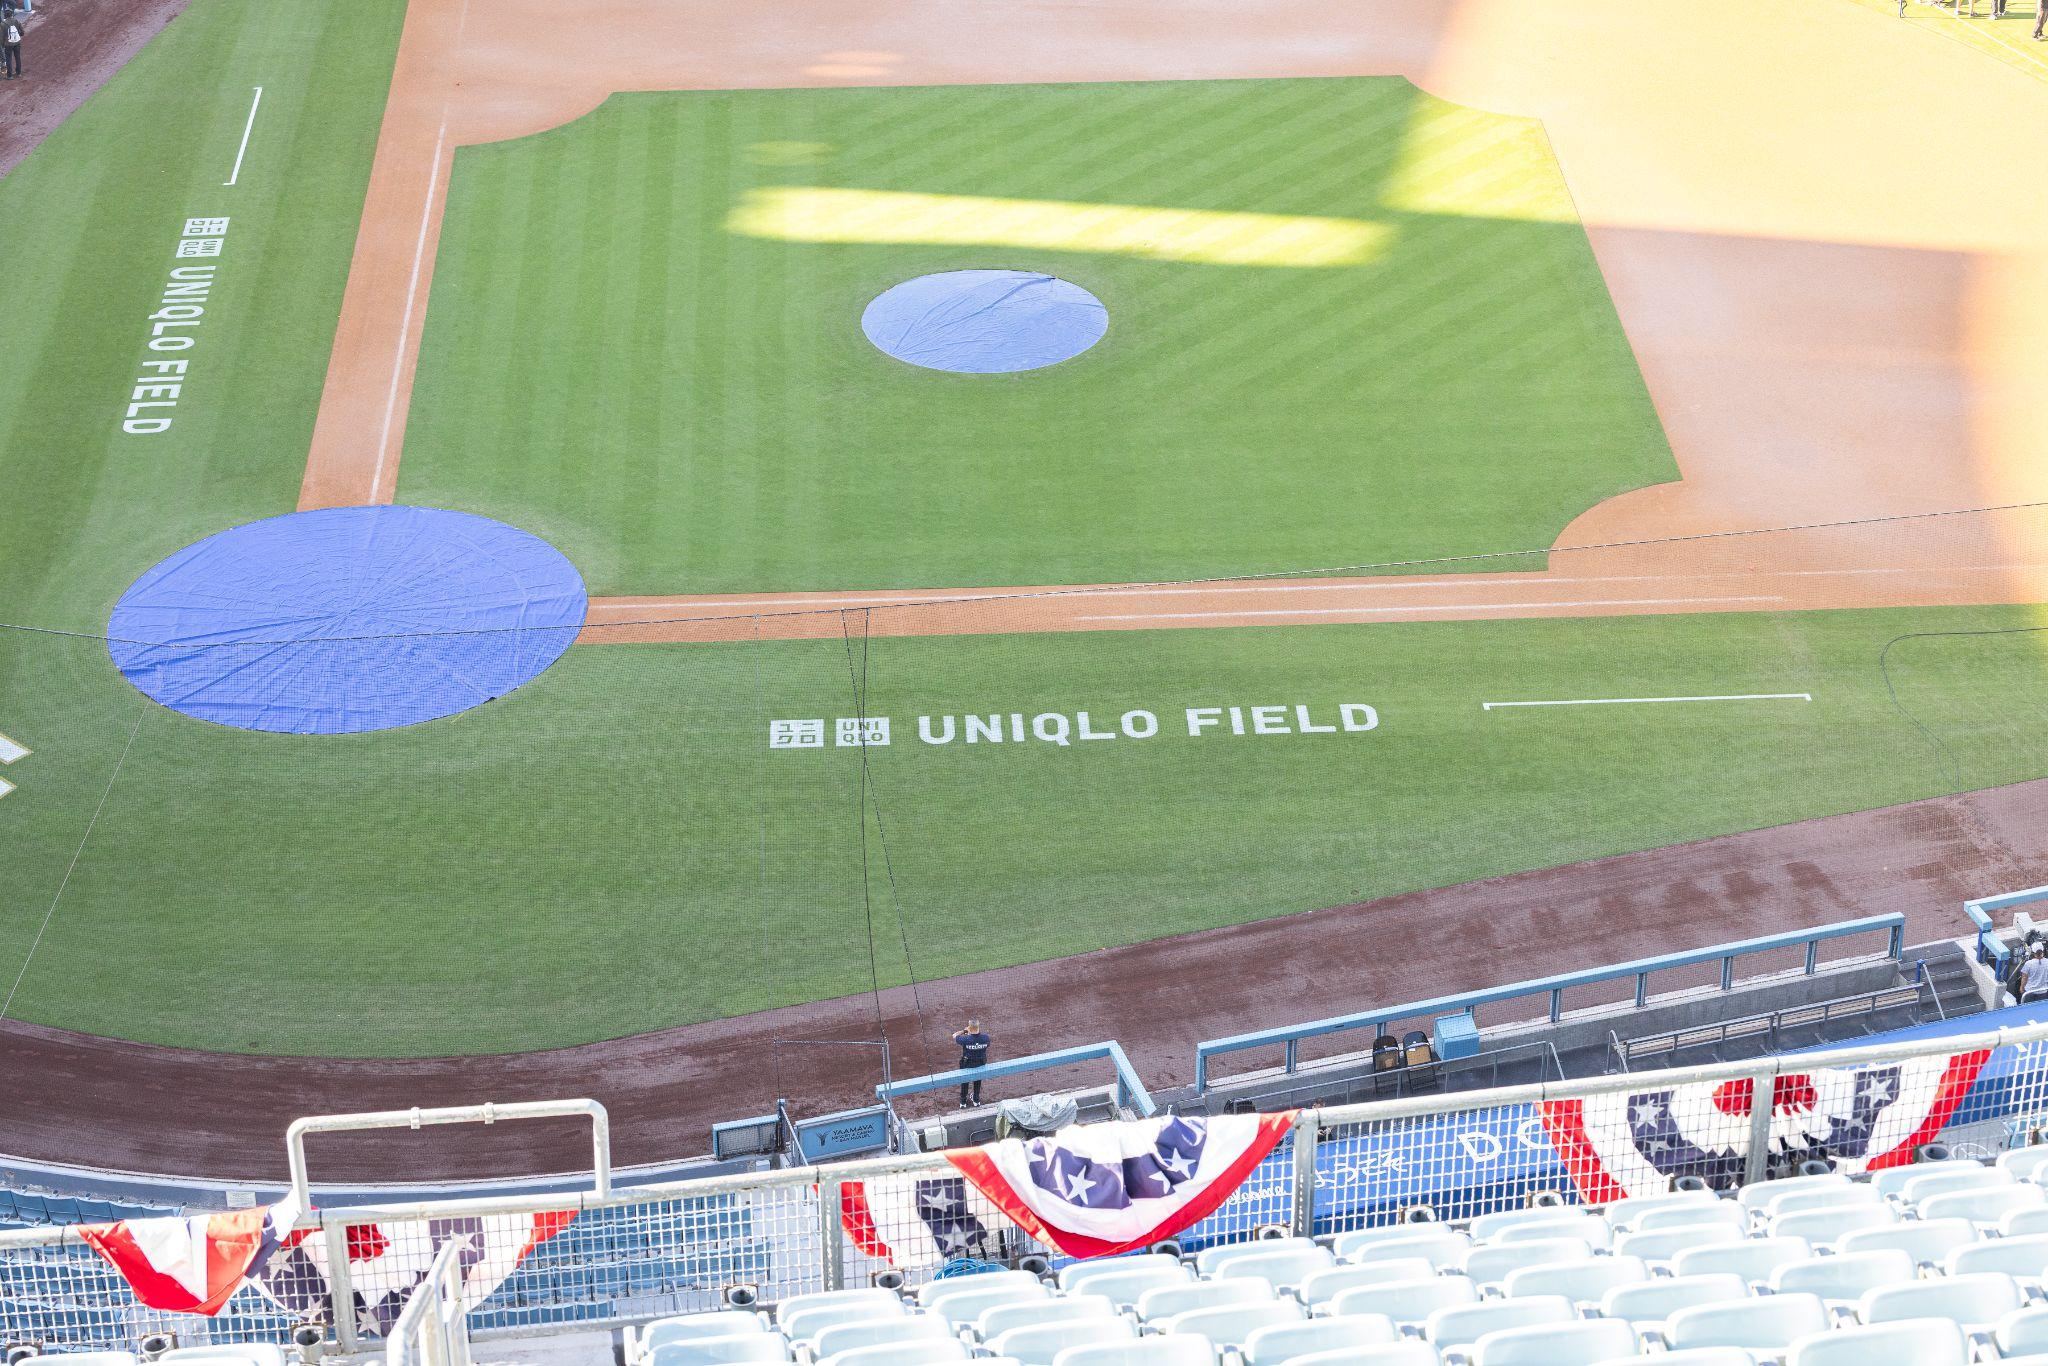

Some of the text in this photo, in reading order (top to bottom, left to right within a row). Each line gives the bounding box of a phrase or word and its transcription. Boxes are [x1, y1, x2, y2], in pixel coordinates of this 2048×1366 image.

[122, 265, 217, 434] UNIQLO FIELD
[842, 721, 879, 731] UNI
[842, 732, 883, 744] QLO
[918, 703, 1380, 746] UNIQLO FIELD
